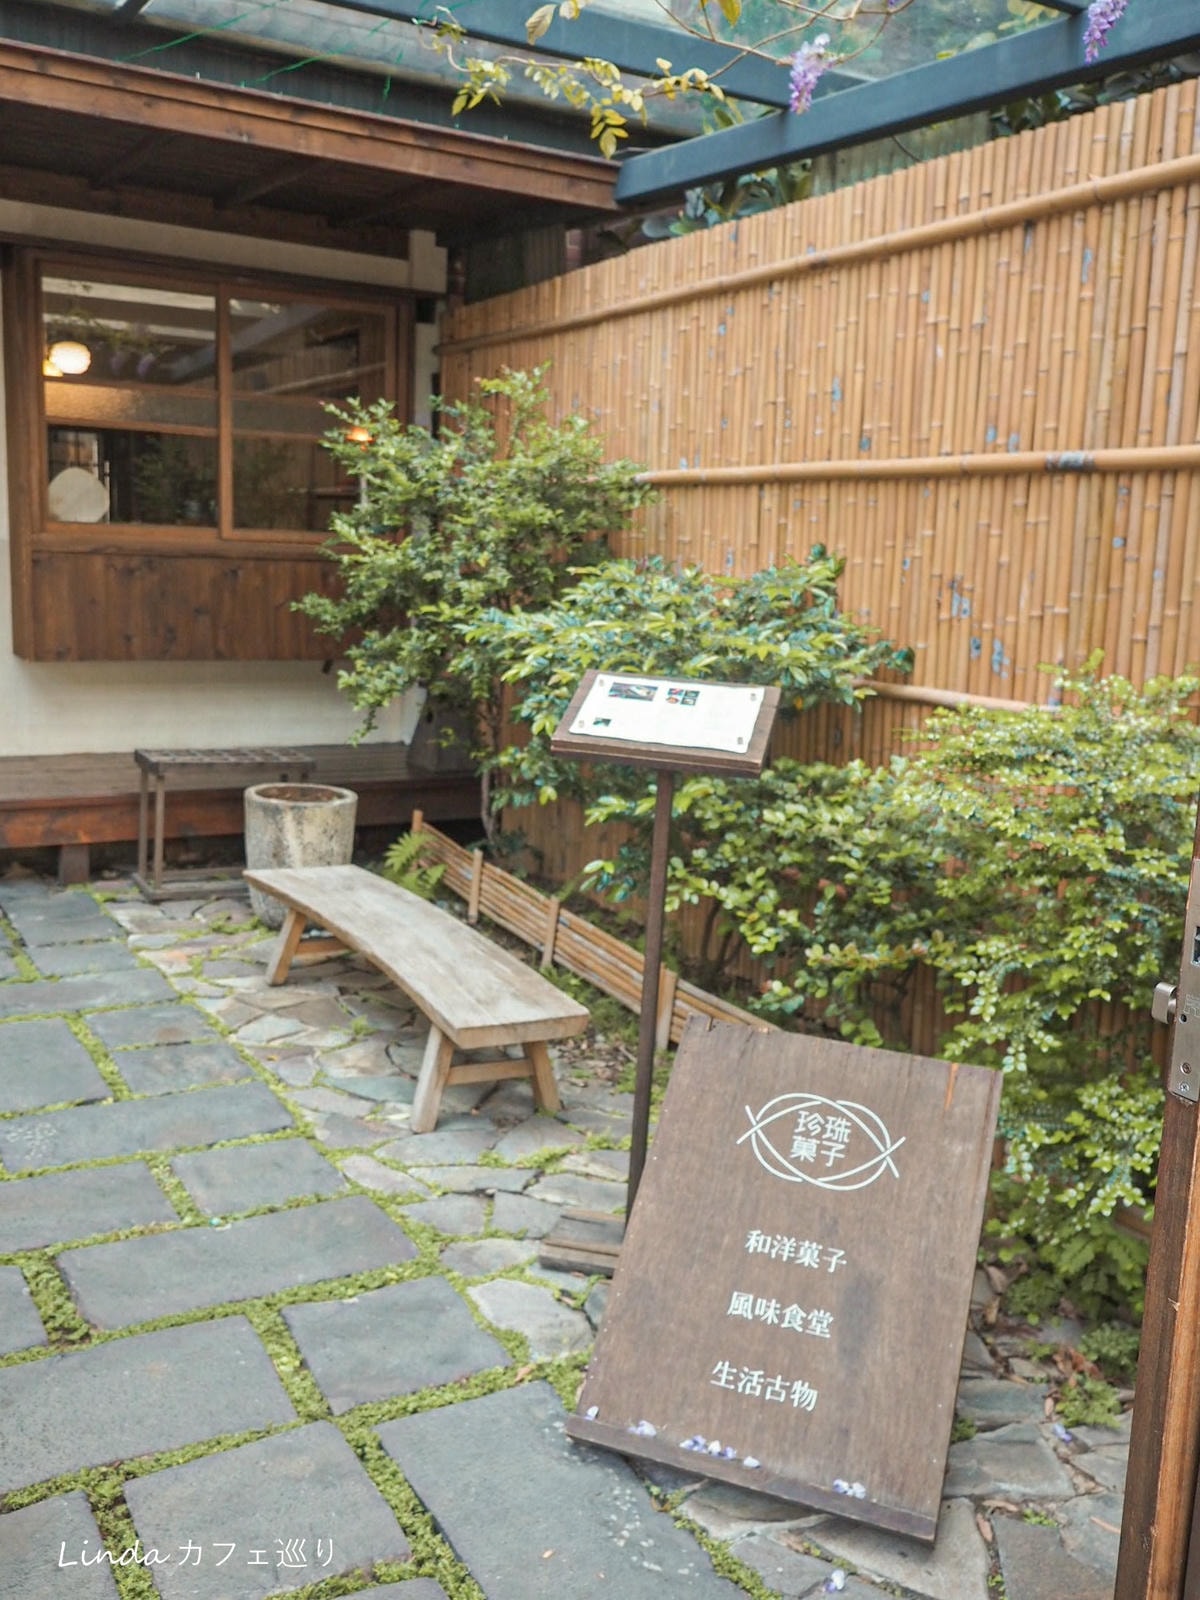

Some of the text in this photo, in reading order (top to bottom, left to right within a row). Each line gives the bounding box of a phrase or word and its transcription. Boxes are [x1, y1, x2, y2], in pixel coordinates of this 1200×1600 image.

[793, 1109, 852, 1143] 珍珠
[789, 1135, 847, 1168] 菓子
[744, 1229, 848, 1273] 和洋菓子
[727, 1290, 834, 1339] 風味食堂
[709, 1360, 819, 1412] 生活古物
